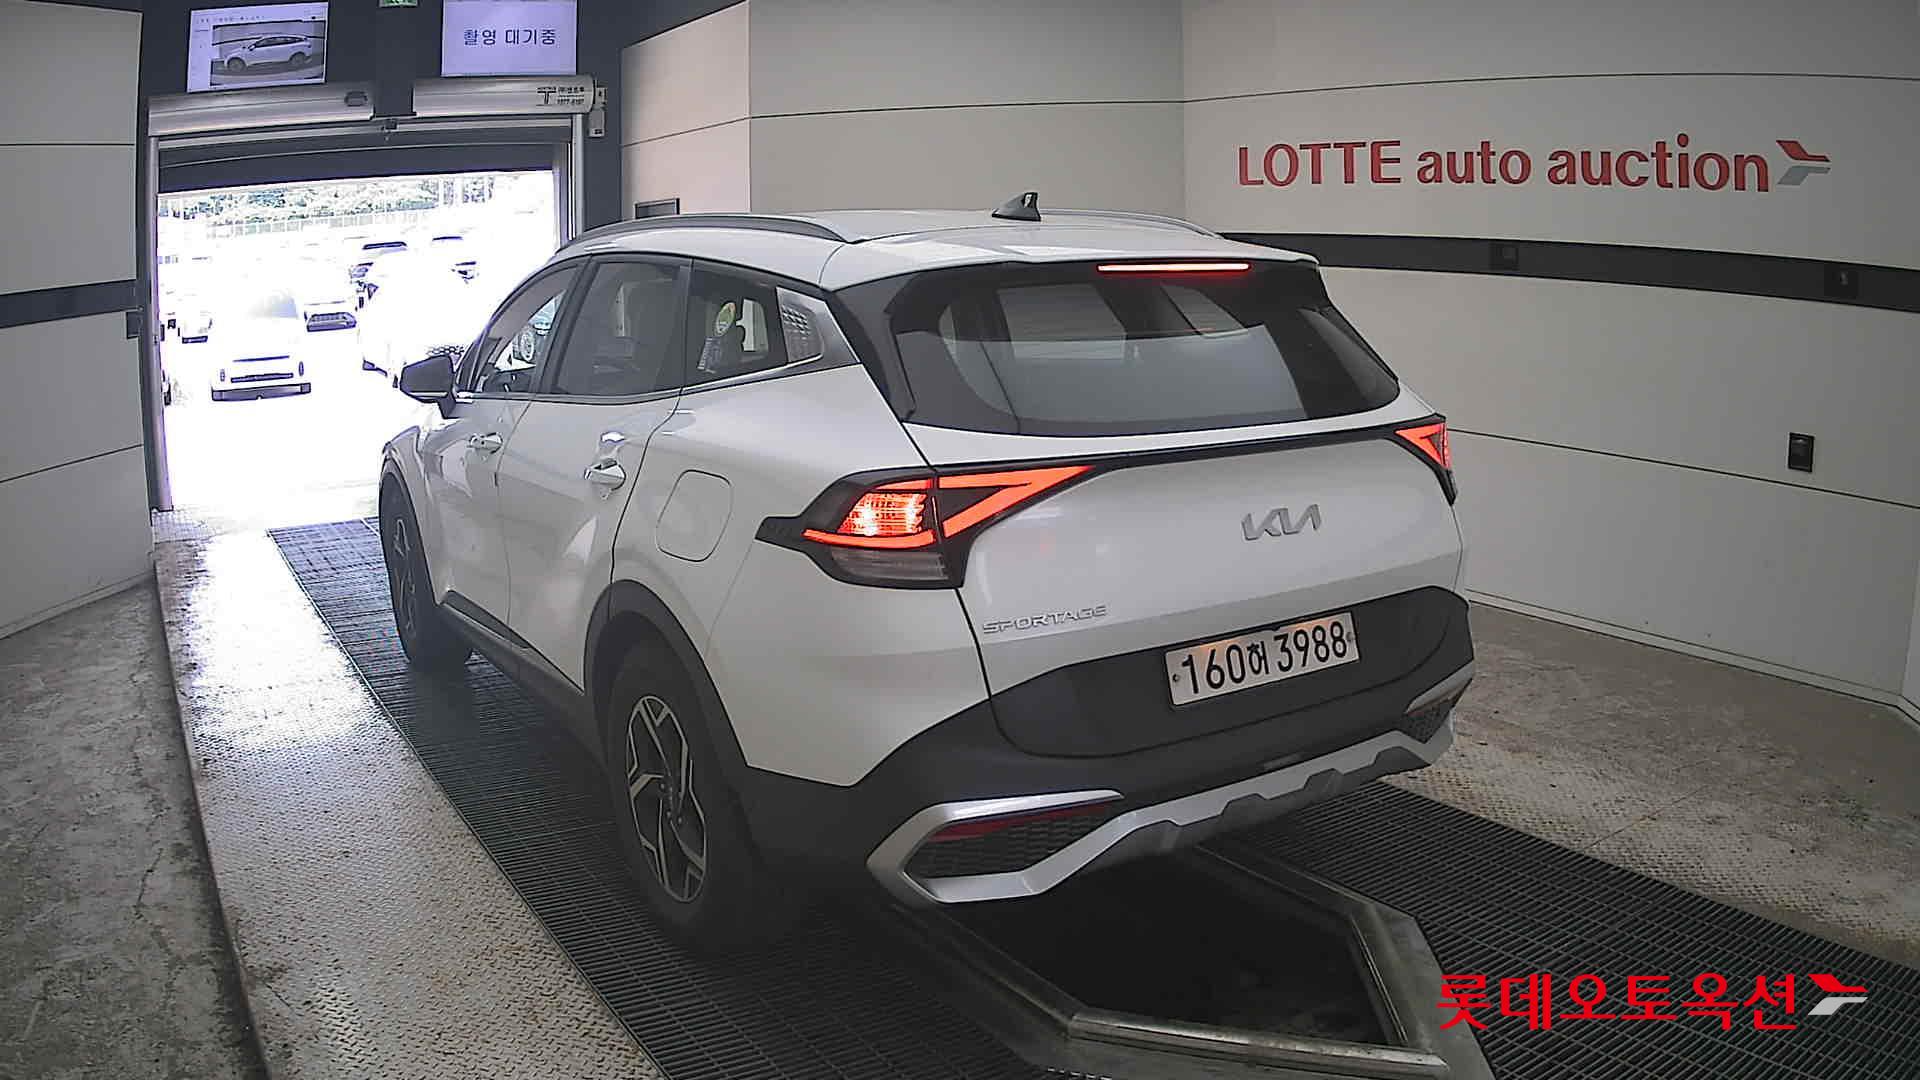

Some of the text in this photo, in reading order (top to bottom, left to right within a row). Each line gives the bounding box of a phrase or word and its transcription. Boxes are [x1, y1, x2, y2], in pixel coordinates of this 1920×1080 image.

[464, 29, 556, 46] 촬영 대기중
[1239, 134, 1770, 191] LOTTE auto auction
[983, 605, 1107, 634] SPORTAGE
